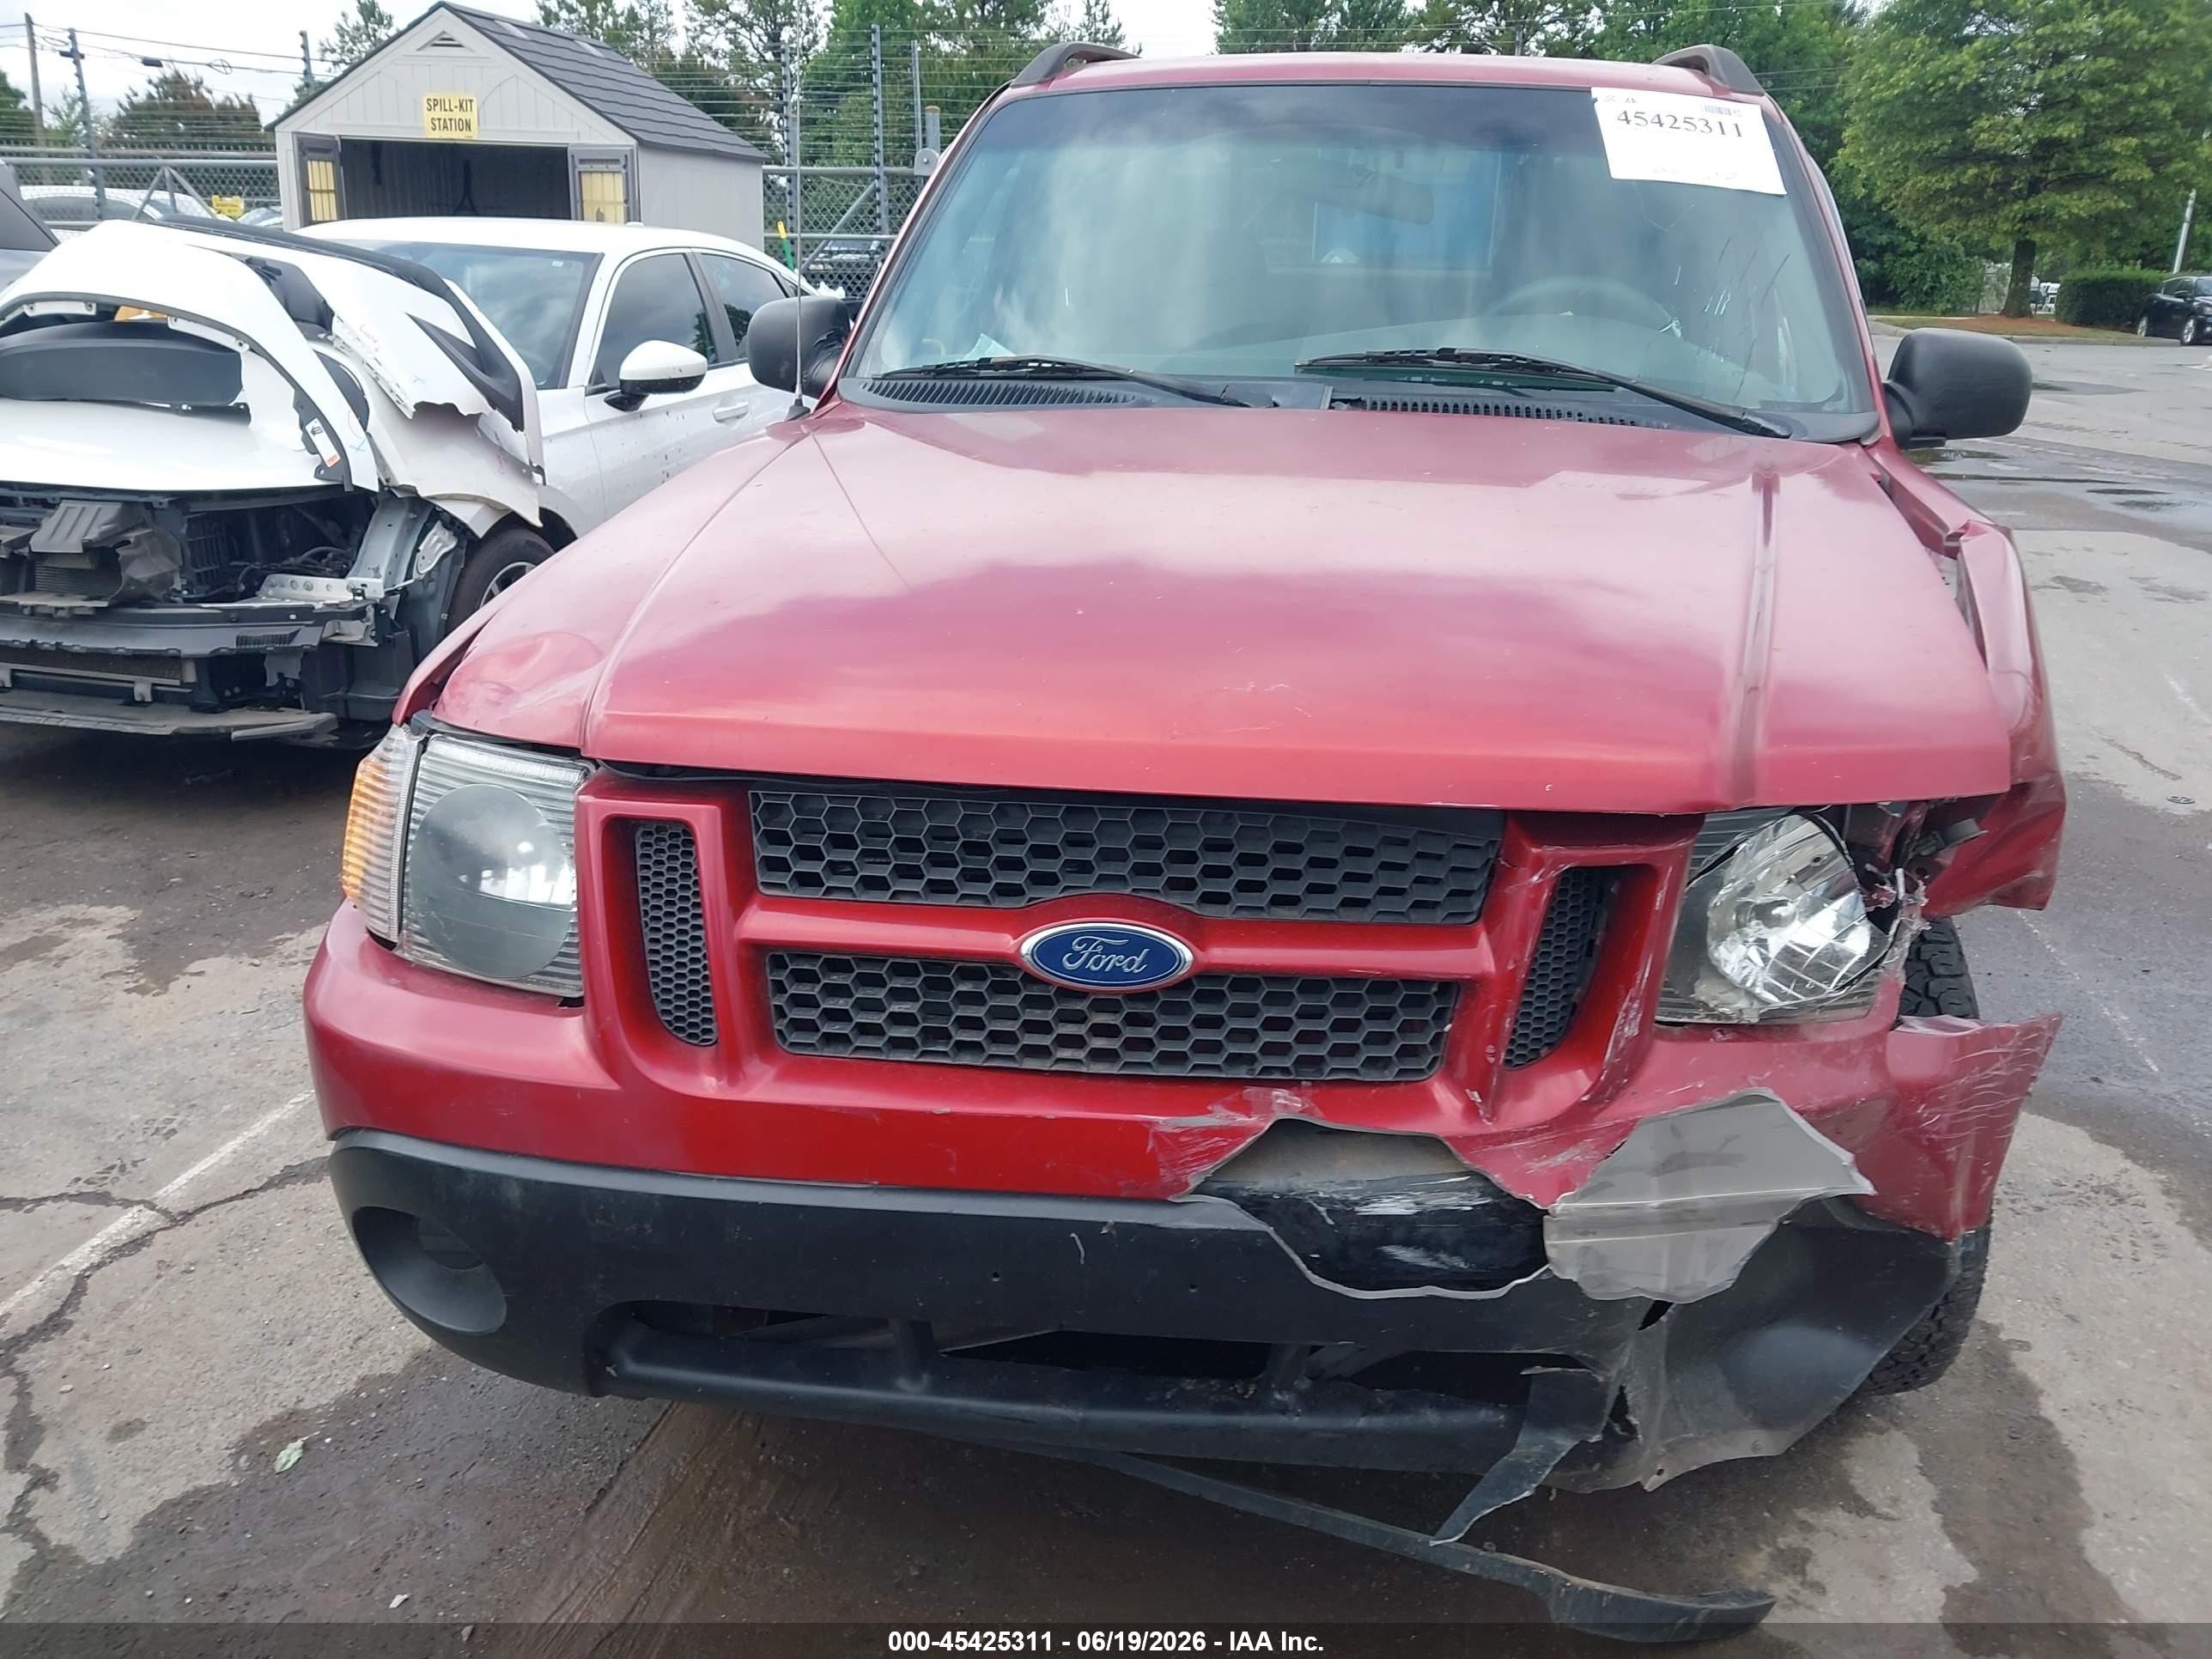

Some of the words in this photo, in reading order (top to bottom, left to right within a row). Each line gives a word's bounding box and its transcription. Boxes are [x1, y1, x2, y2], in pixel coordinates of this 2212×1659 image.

[426, 98, 474, 112] SPILL-KIT
[430, 118, 471, 132] STATION
[1616, 109, 1744, 138] 45425311
[1061, 935, 1151, 974] Ford
